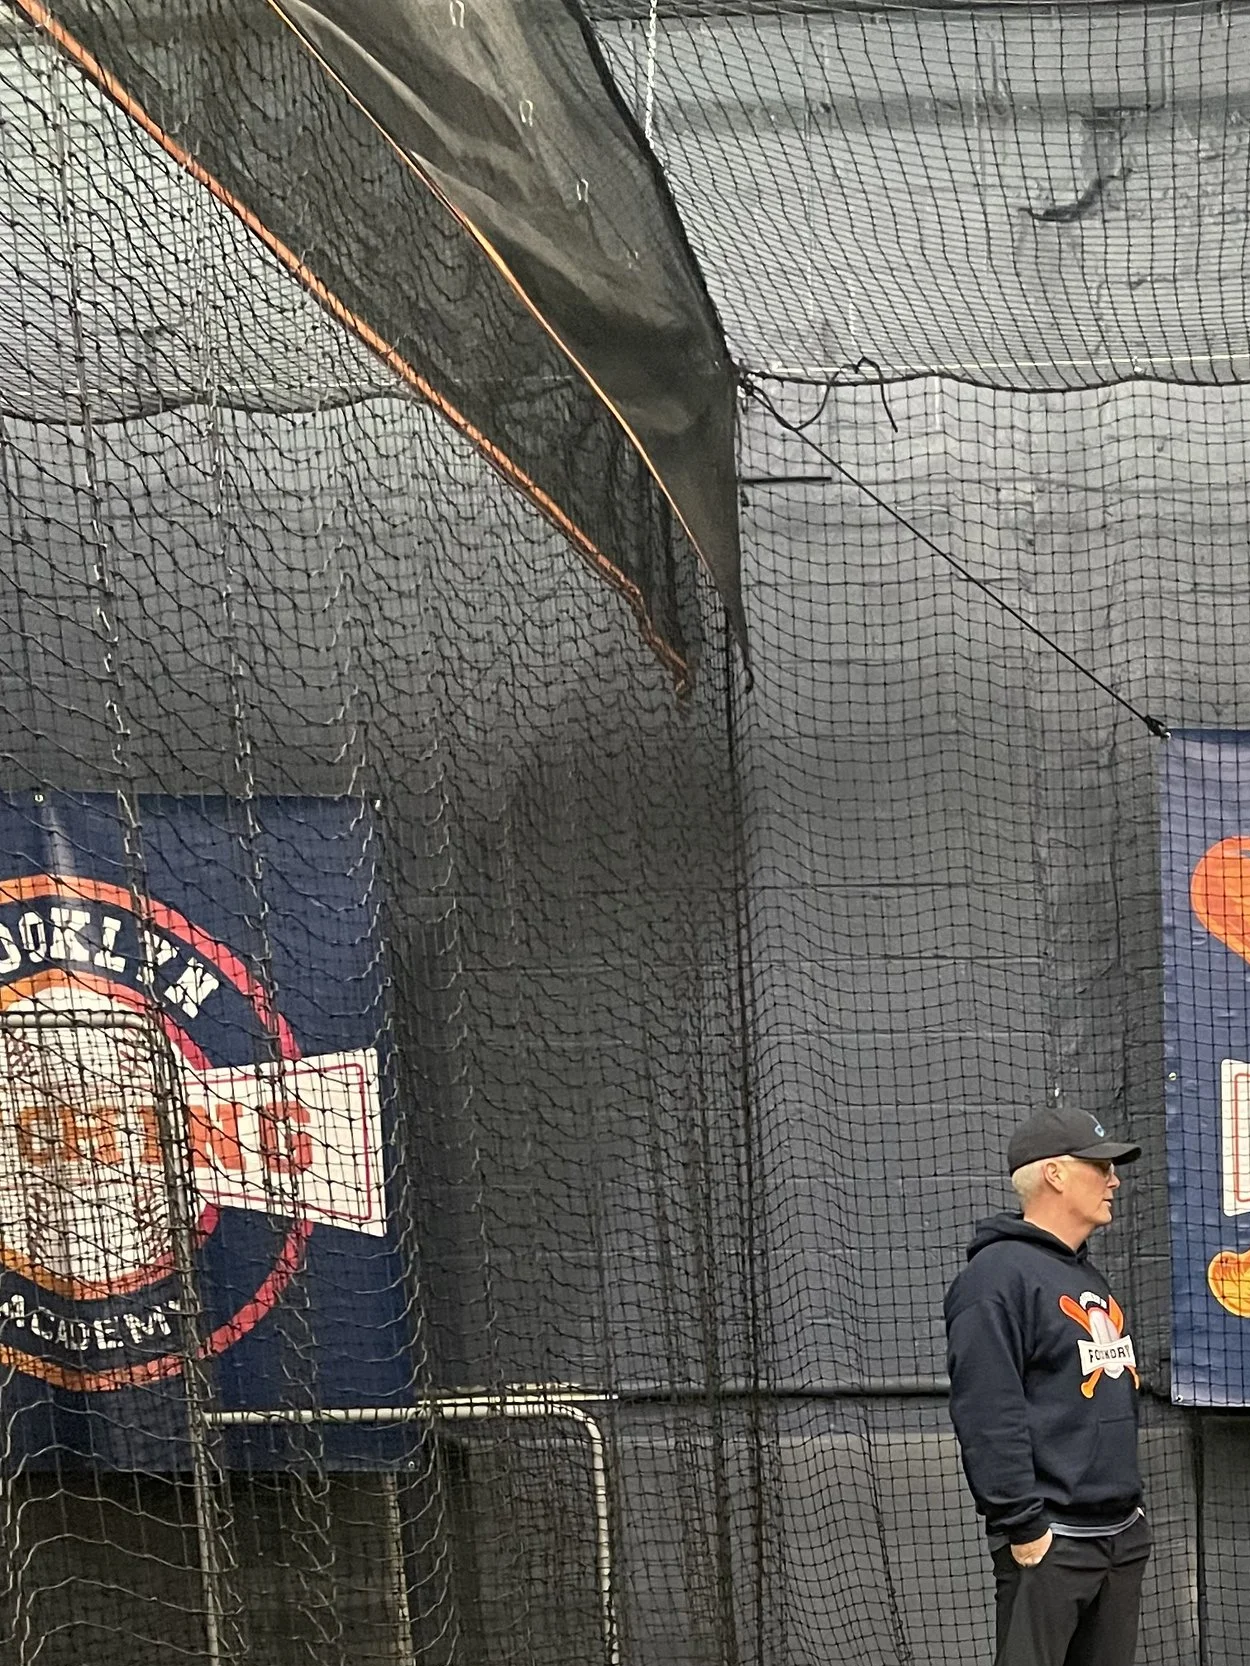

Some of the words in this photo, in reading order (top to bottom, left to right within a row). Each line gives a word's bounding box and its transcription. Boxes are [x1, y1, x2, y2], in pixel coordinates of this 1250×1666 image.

[0, 907, 219, 1019] OOKLYN
[17, 1101, 312, 1175] CHING
[0, 1294, 181, 1350] ACADEM
